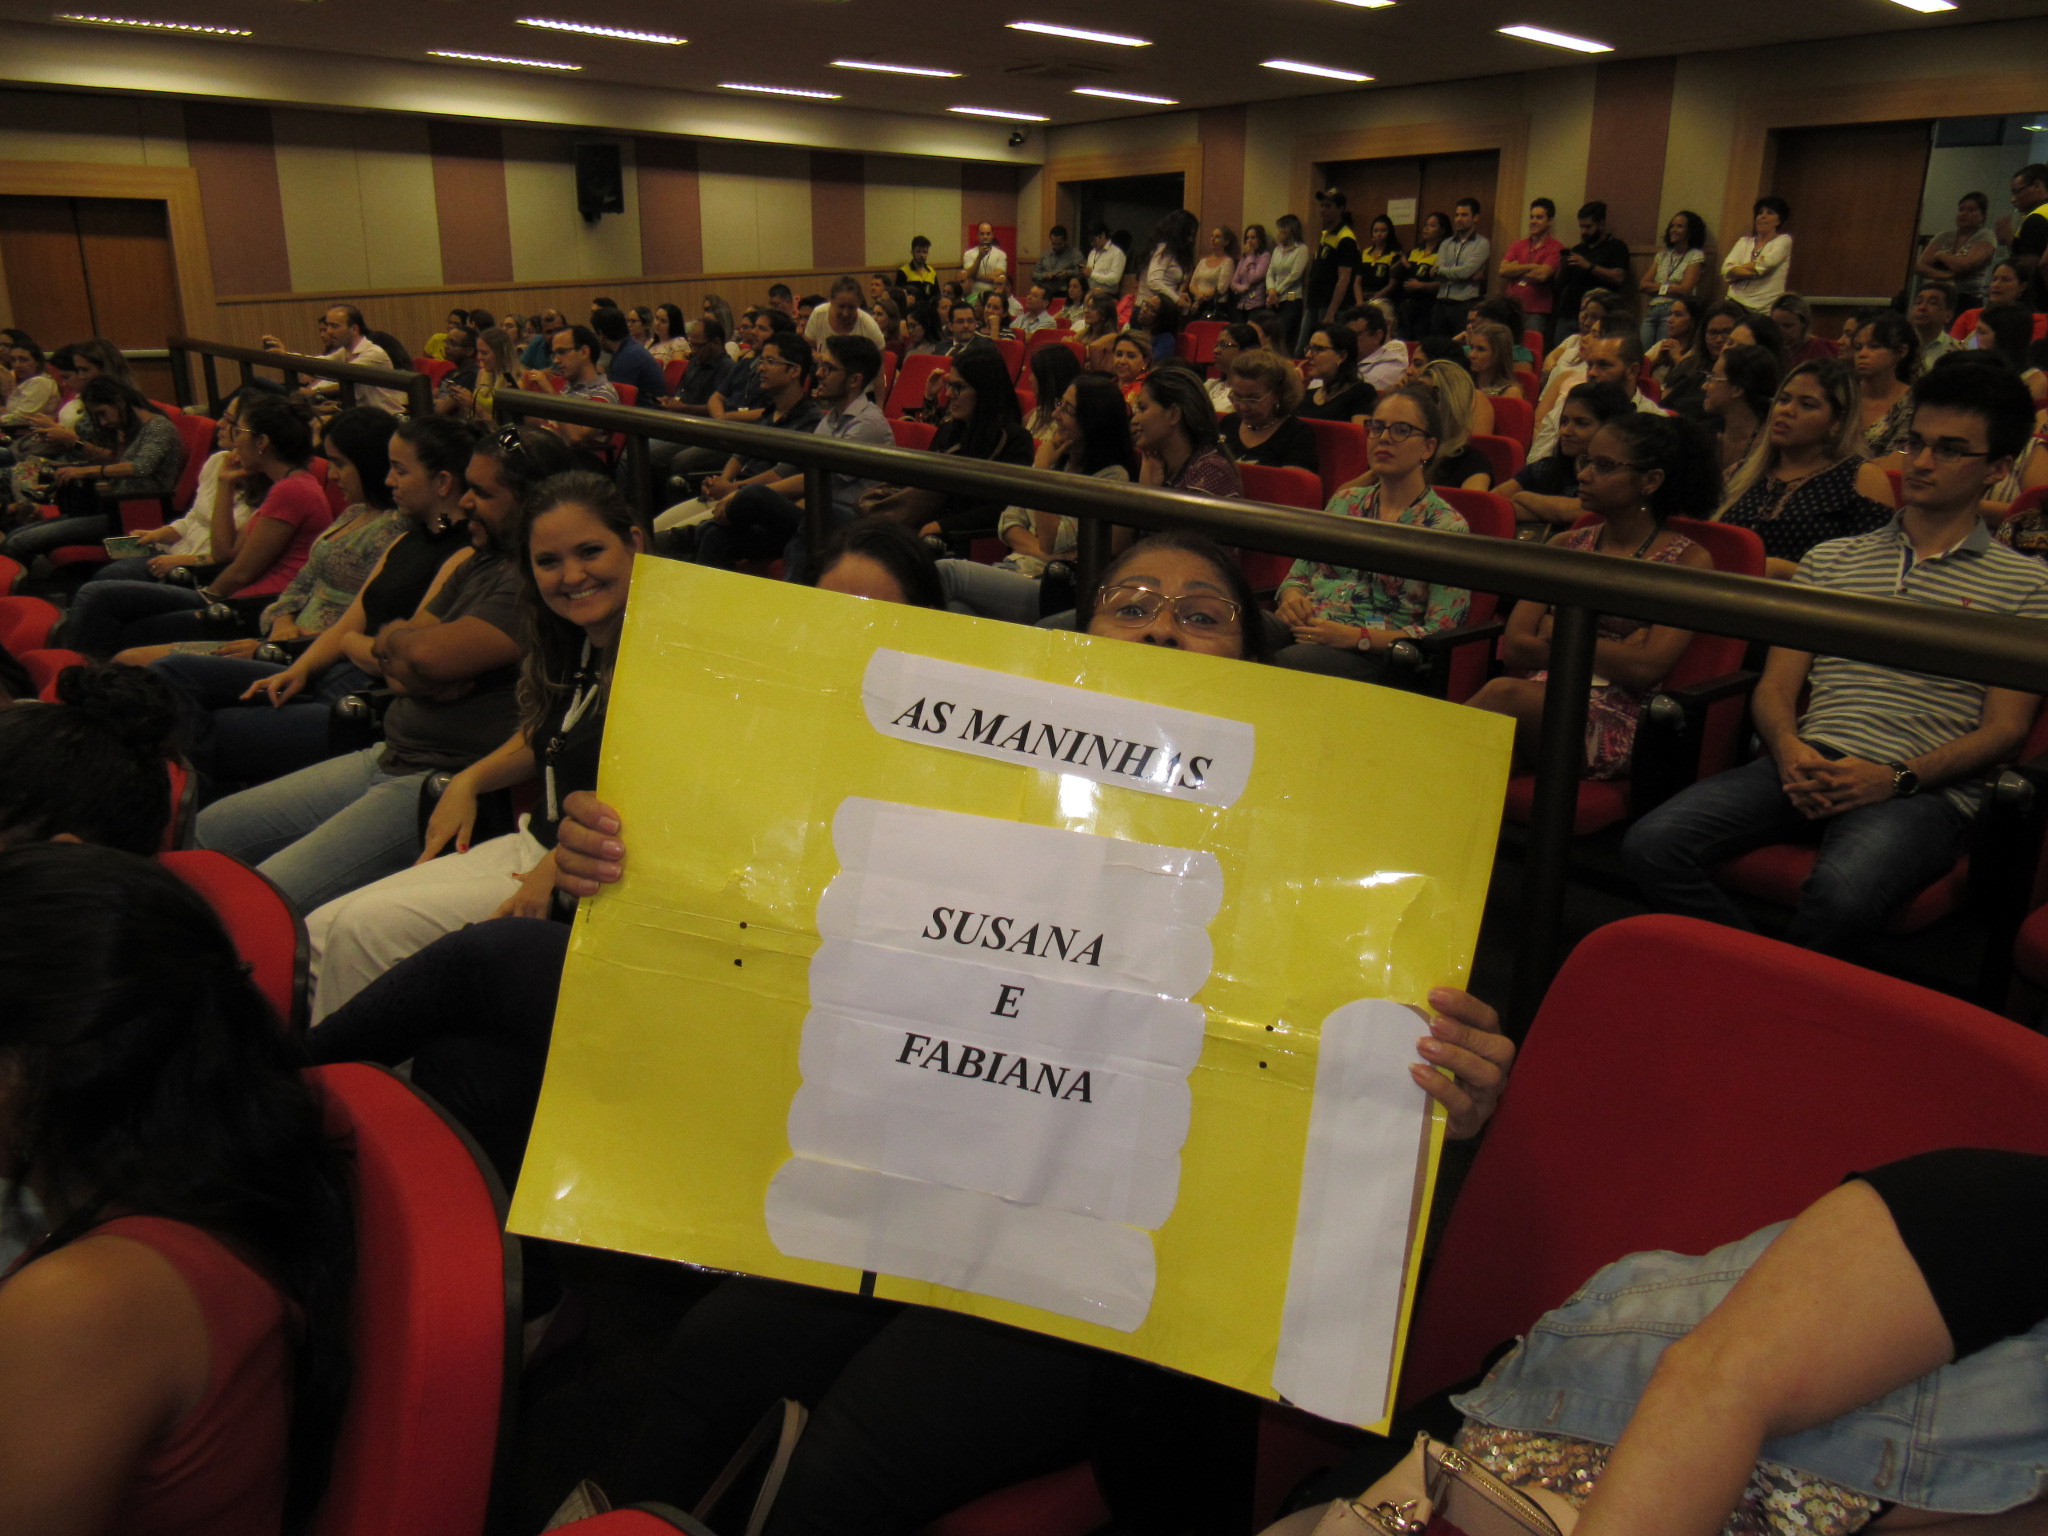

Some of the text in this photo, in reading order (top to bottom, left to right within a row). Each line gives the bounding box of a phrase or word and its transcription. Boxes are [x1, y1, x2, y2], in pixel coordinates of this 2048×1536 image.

[892, 697, 956, 735] AS
[921, 906, 1104, 967] SUSANA
[990, 984, 1025, 1018] E
[895, 1032, 1093, 1104] FABIANA
